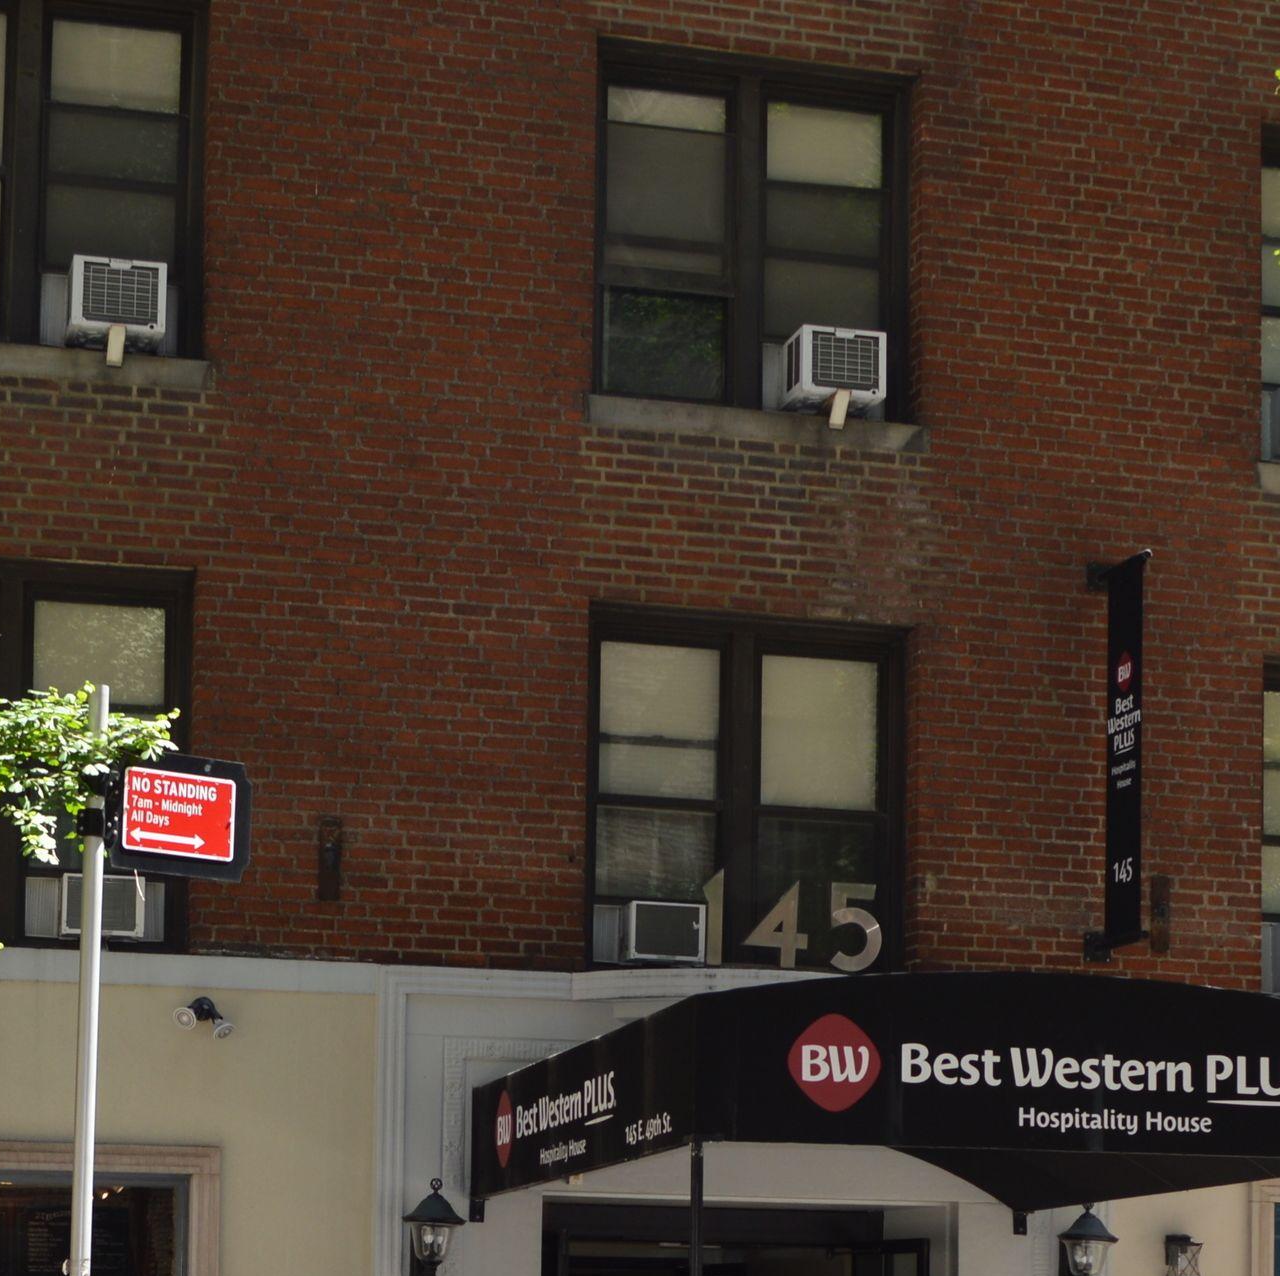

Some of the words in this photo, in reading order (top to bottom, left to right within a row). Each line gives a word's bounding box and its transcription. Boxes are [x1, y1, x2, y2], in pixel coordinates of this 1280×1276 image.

[1118, 662, 1131, 682] BW
[1115, 694, 1134, 715] Best
[1108, 709, 1141, 735] Western
[1114, 728, 1135, 751] PLUS
[132, 776, 150, 792] NO
[154, 779, 217, 802] STANDING
[131, 810, 144, 822] All
[146, 812, 170, 827] Days
[132, 795, 153, 810] 7am
[161, 799, 203, 816] Midnight
[1113, 857, 1132, 883] 145
[703, 867, 883, 973] 145
[801, 1044, 869, 1083] BW
[900, 1042, 1002, 1088] Best
[1010, 1046, 1194, 1094] Western
[516, 1100, 538, 1139] Best
[538, 1090, 583, 1131] Western
[584, 1071, 616, 1117] PLUS
[496, 1114, 512, 1146] BW
[625, 1125, 637, 1146] 145
[646, 1114, 662, 1140] 49th
[1018, 1107, 1139, 1135] Hospitality
[1146, 1110, 1212, 1134] House
[540, 1141, 569, 1167] Hospitality
[570, 1138, 587, 1158] House
